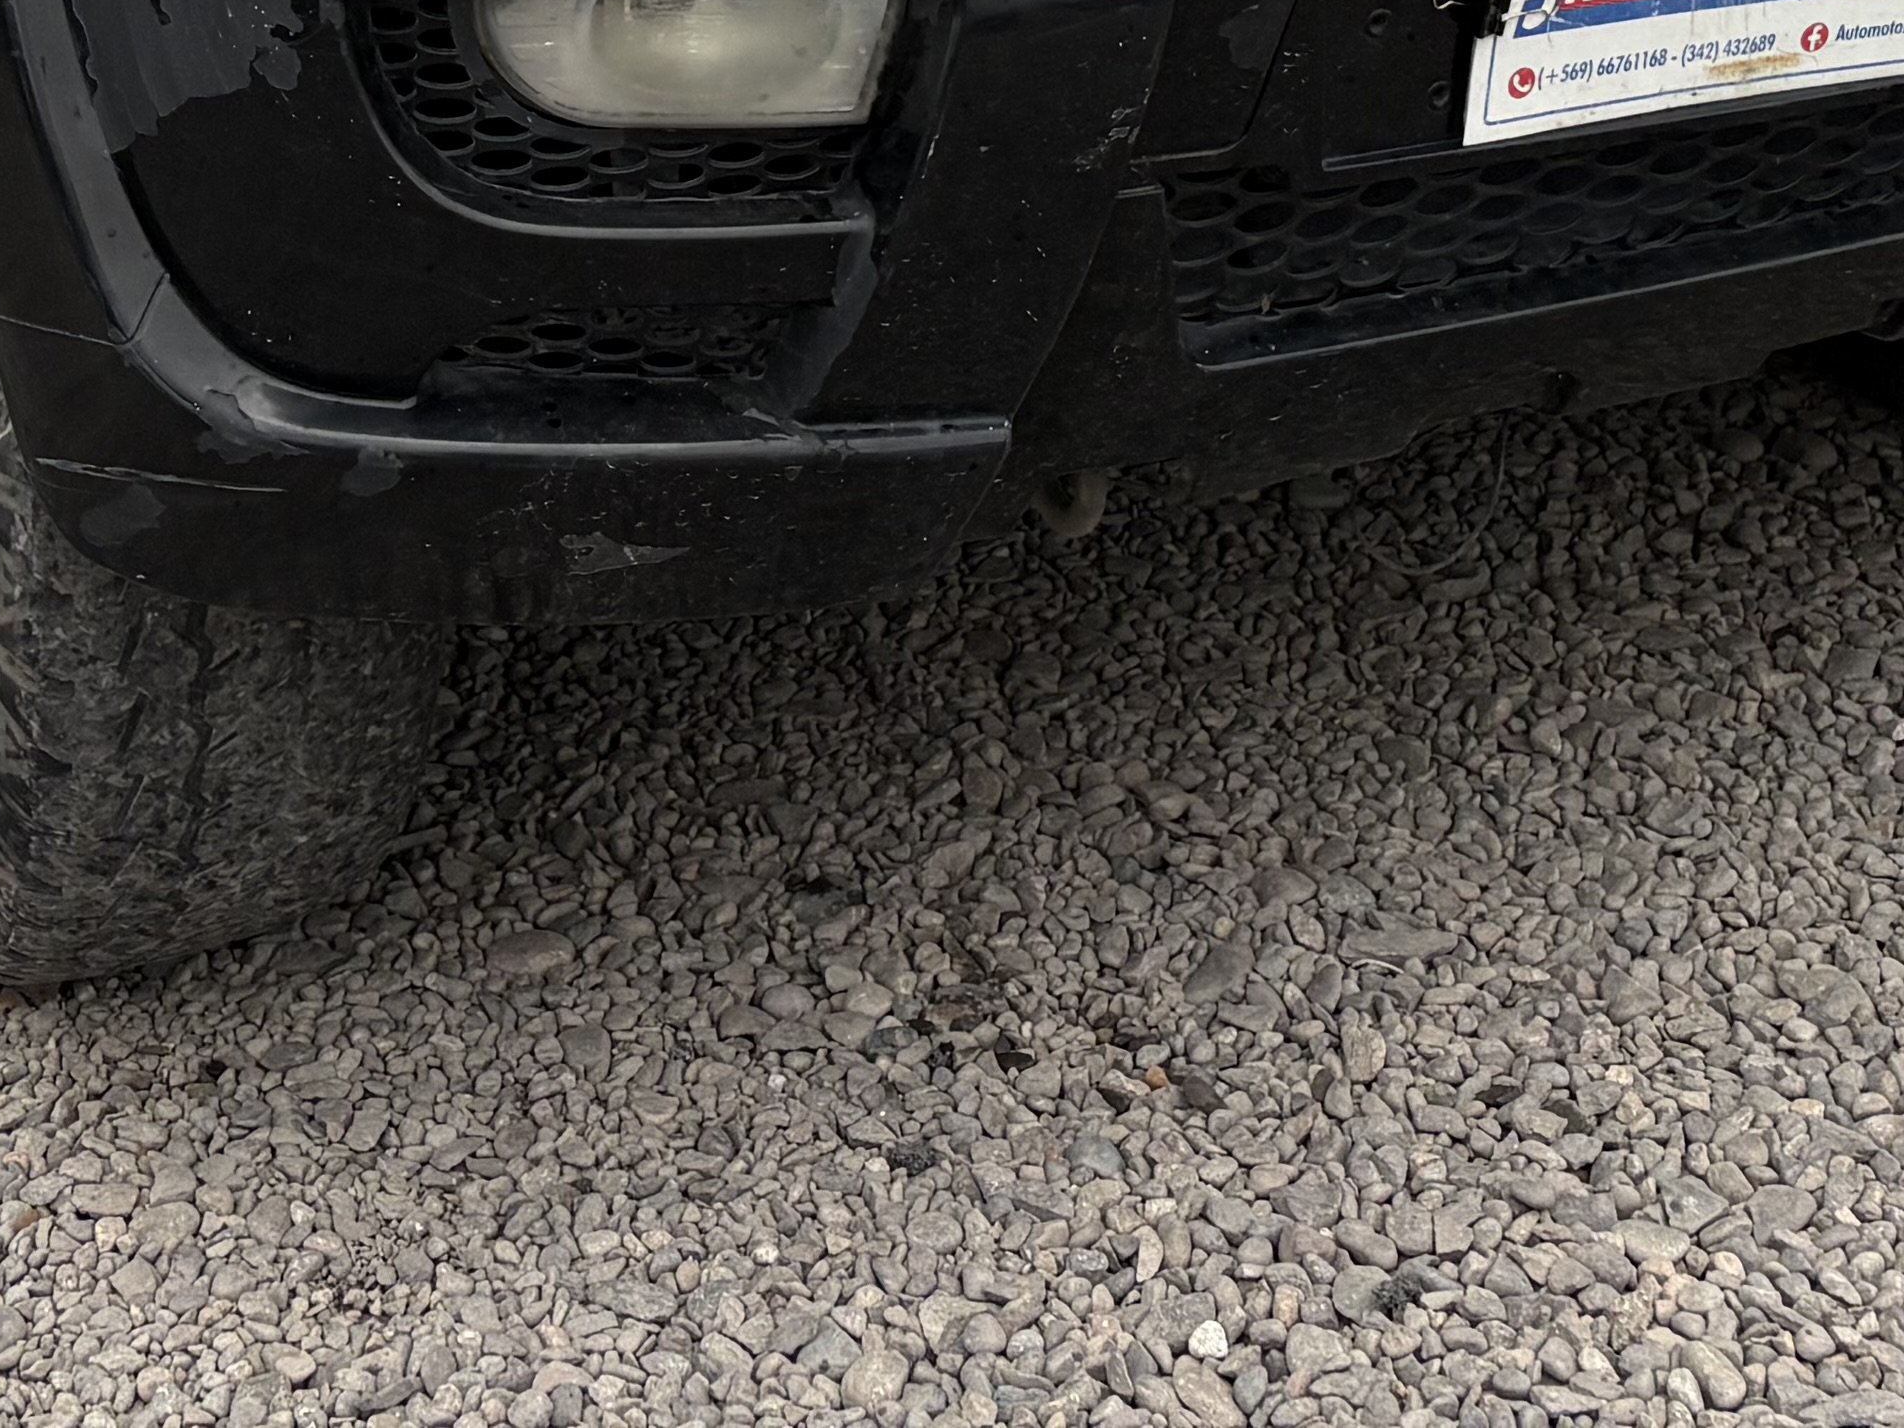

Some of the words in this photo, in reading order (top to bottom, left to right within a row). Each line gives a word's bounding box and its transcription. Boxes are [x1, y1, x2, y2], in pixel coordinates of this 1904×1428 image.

[1597, 48, 1667, 76] 66761168
[1681, 41, 1718, 67] (342)
[1723, 33, 1776, 57] 432689
